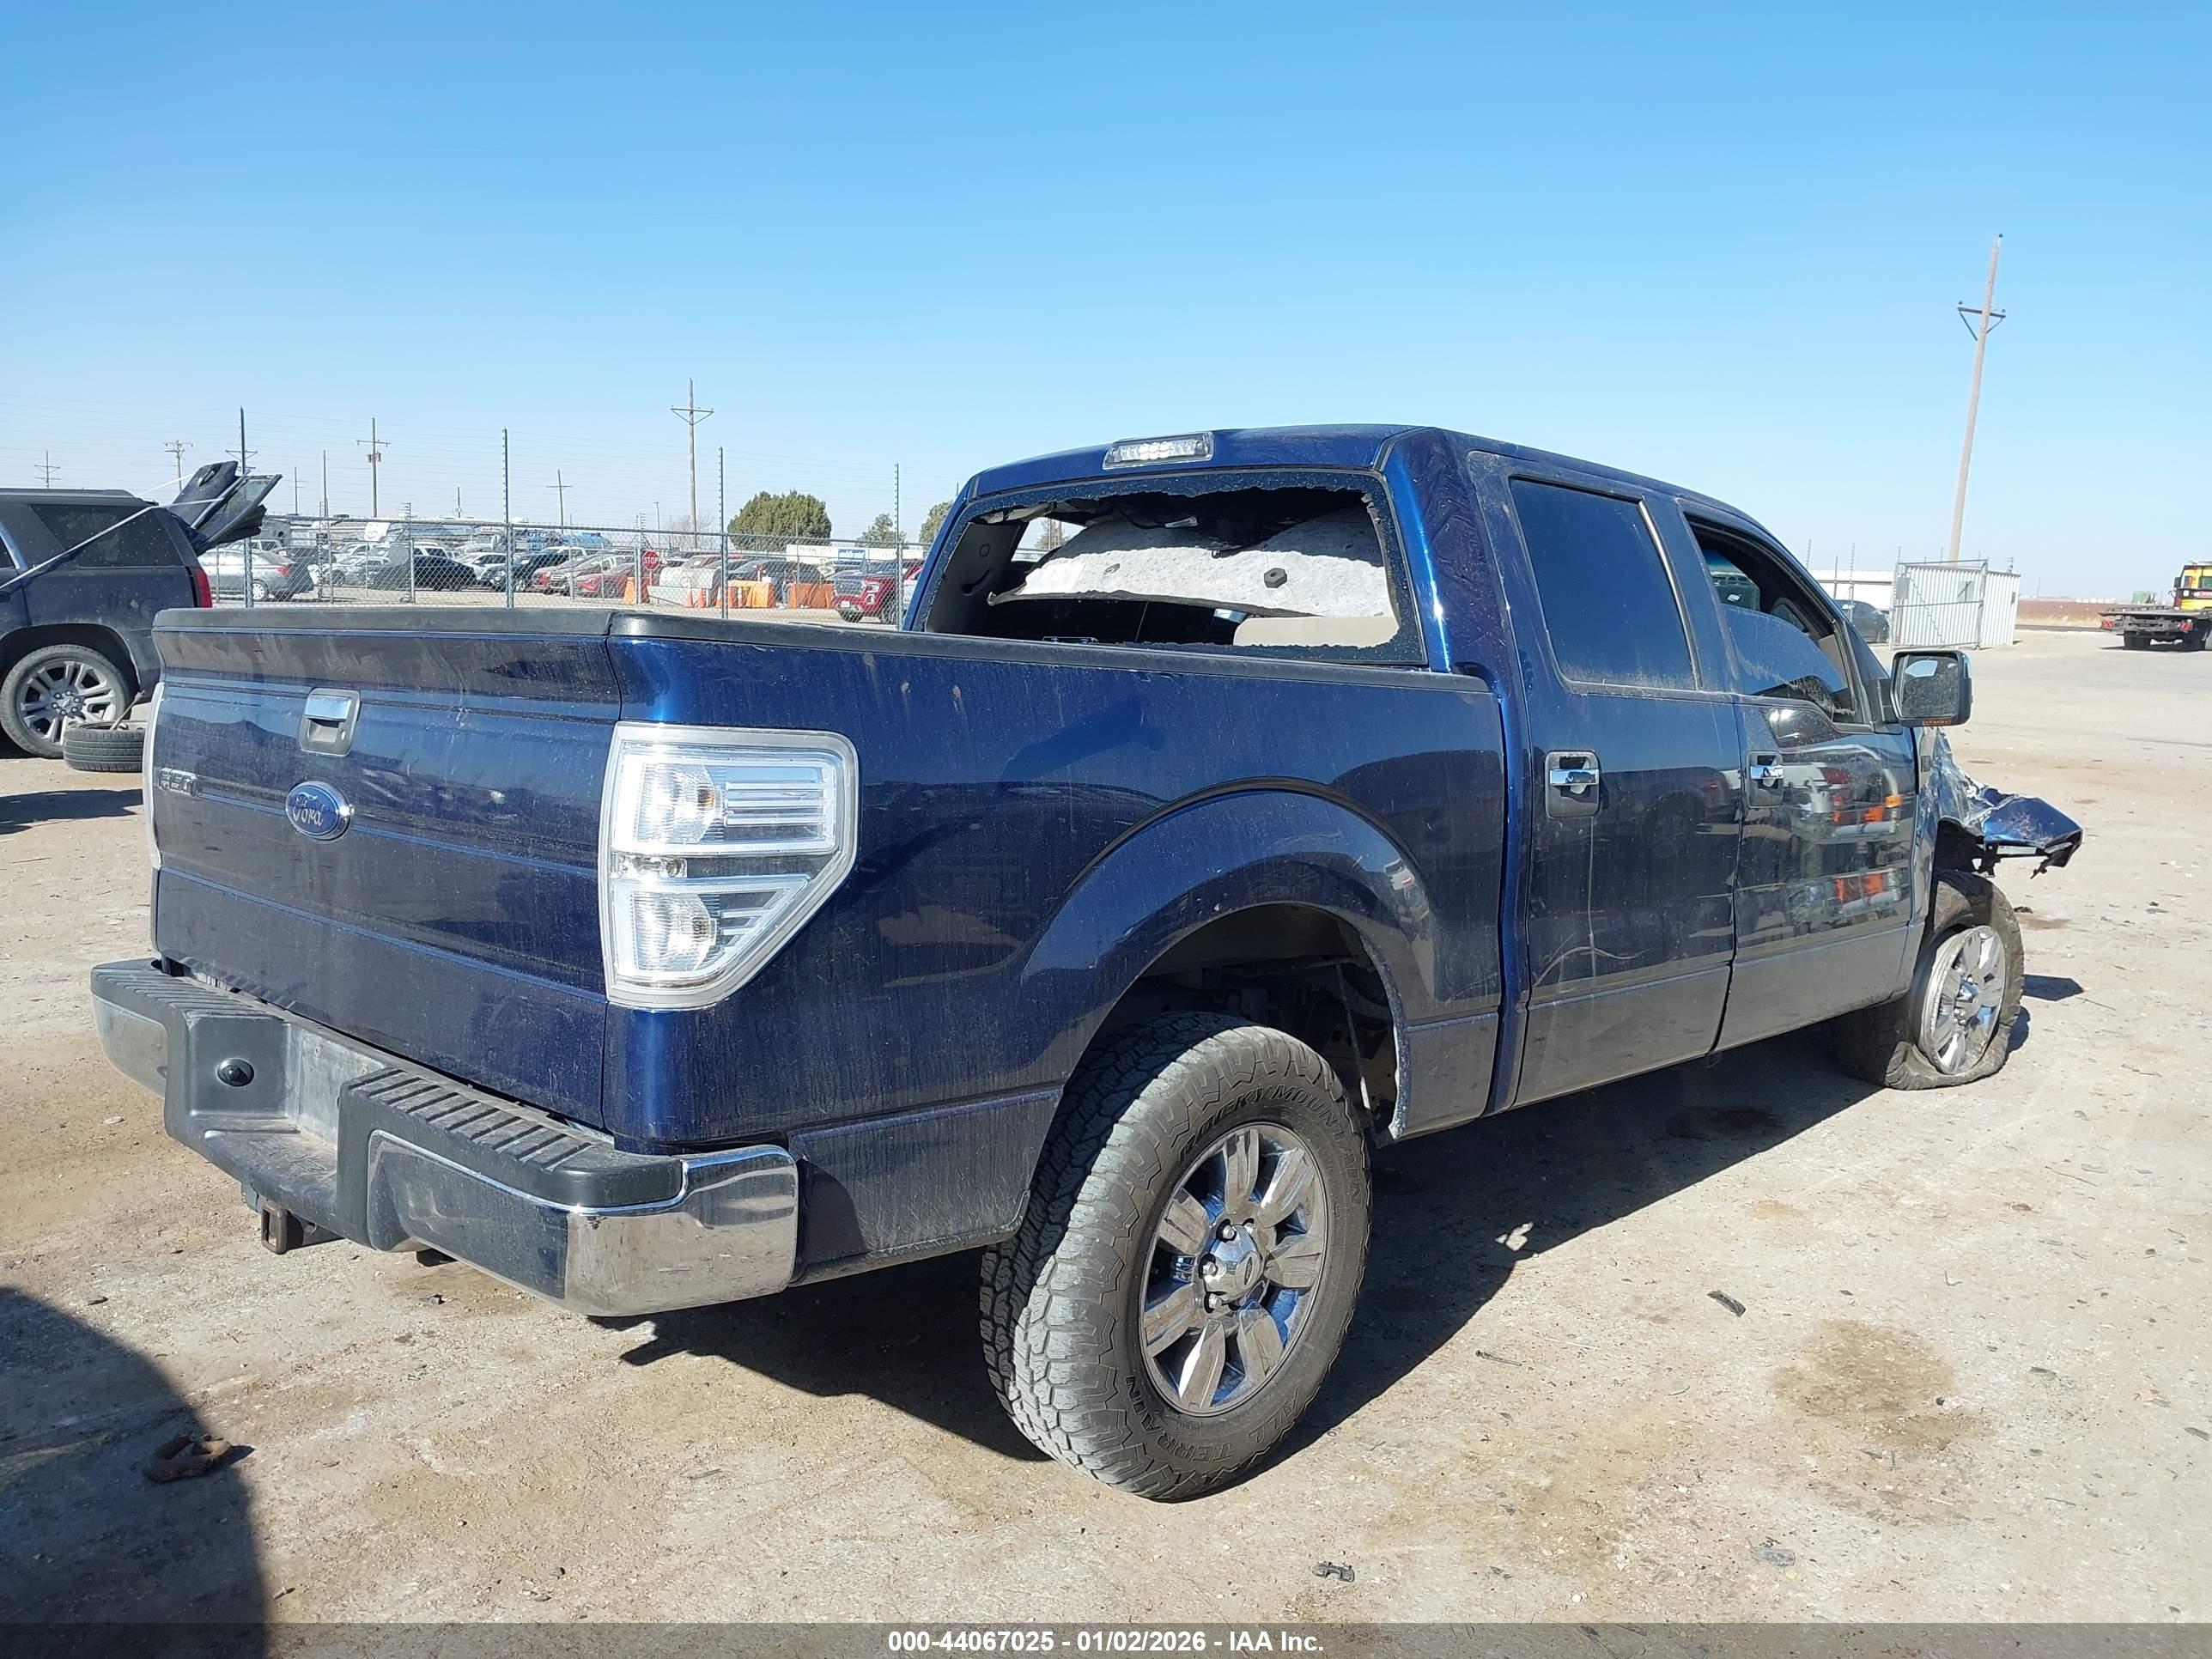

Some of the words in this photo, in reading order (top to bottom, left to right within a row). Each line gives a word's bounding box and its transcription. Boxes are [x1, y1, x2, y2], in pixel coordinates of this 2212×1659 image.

[292, 792, 325, 826] Ford
[1270, 1085, 1363, 1206] MOUNTAIN
[1126, 1376, 1233, 1462] TERRAIN
[1247, 1387, 1300, 1445] ALL
